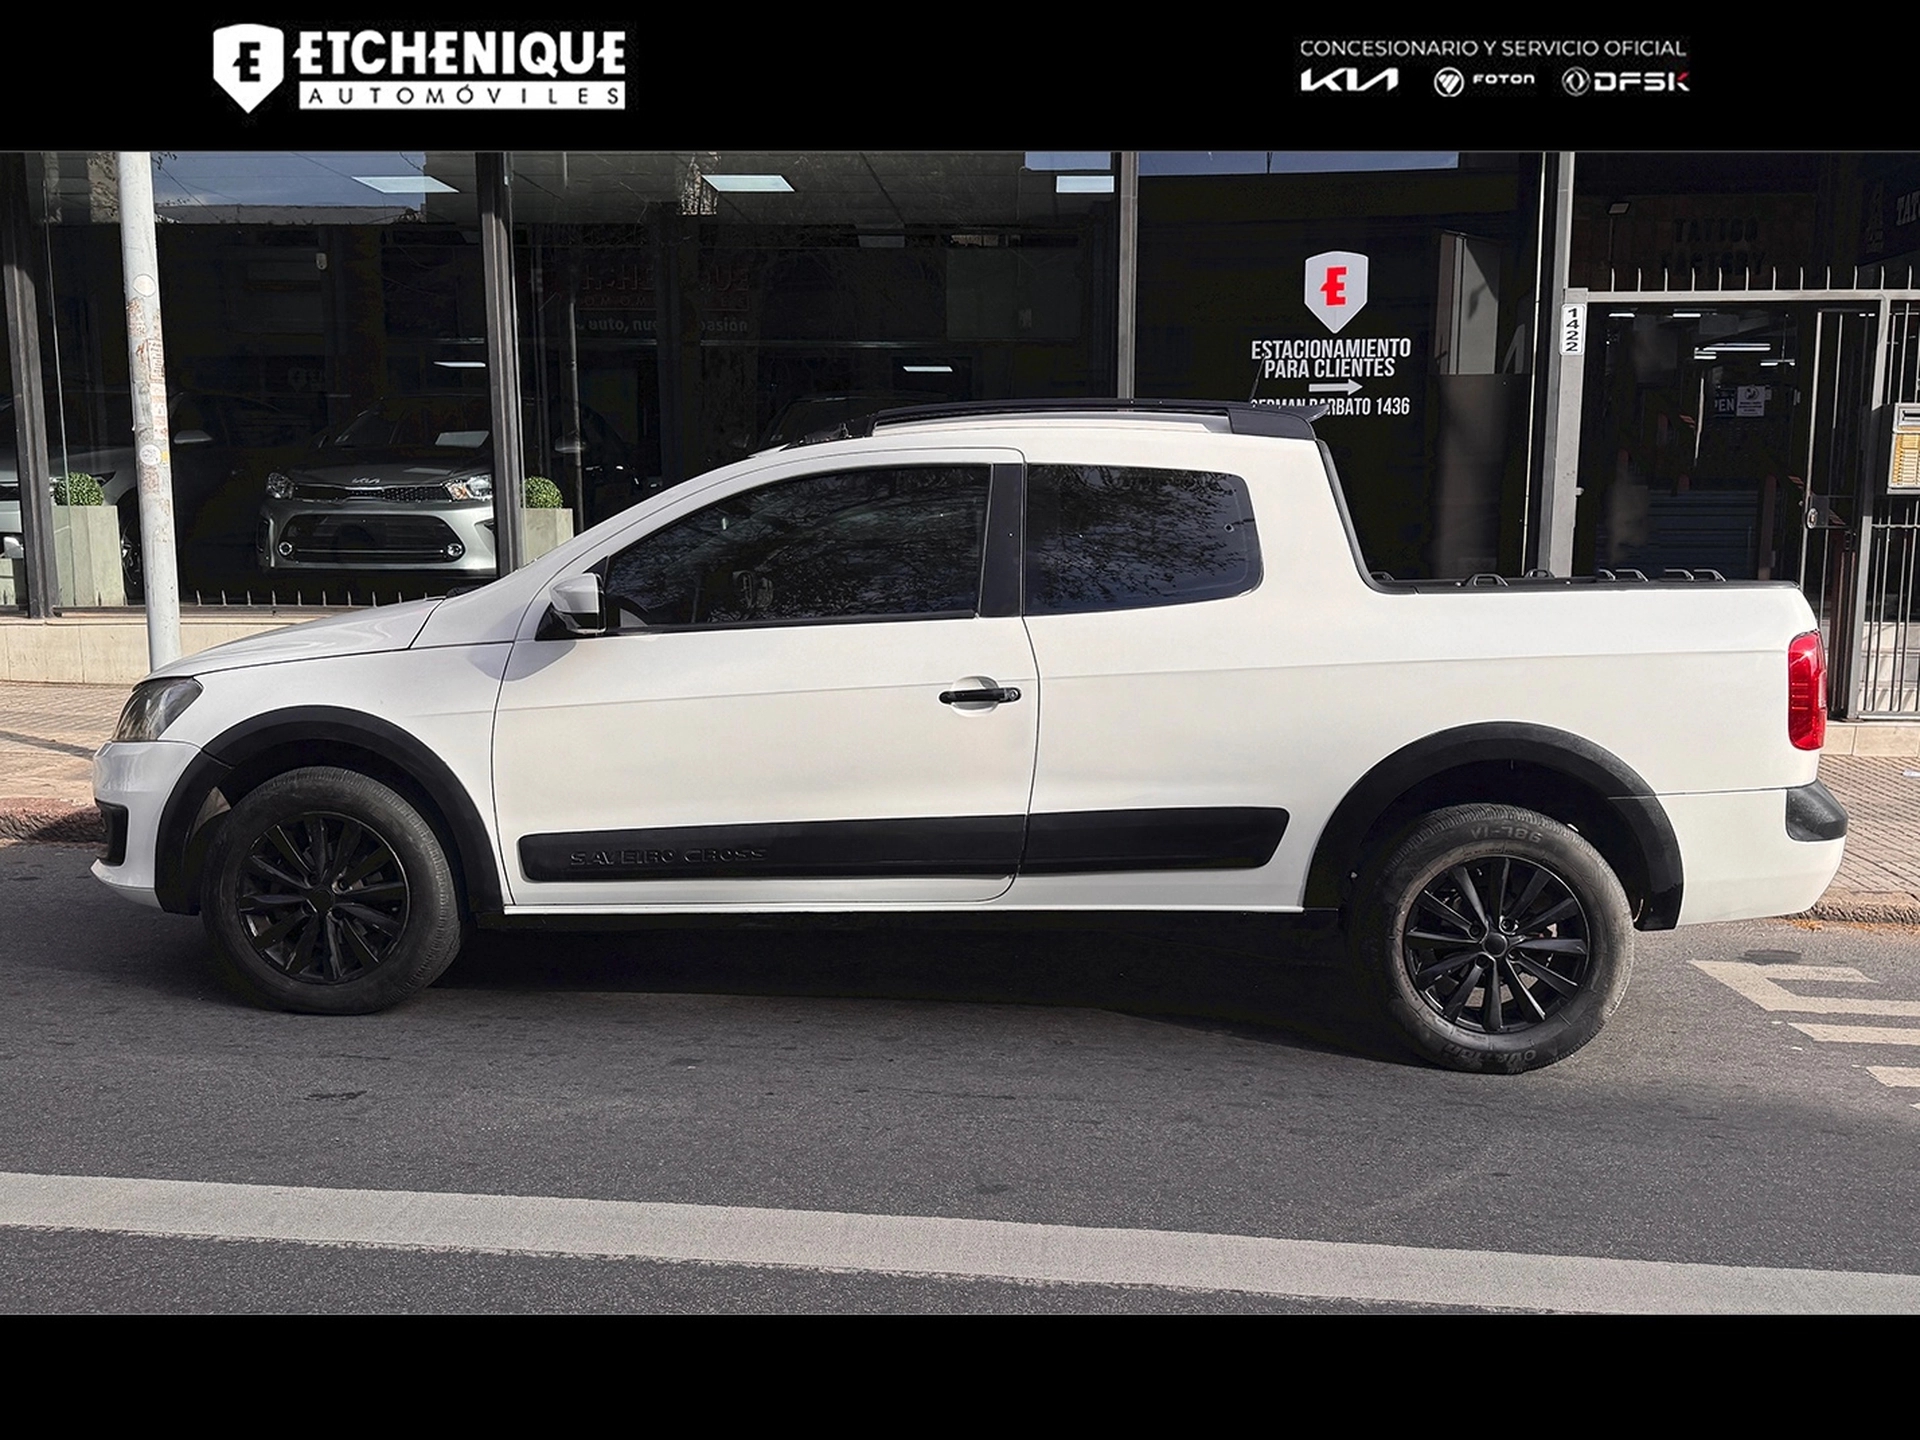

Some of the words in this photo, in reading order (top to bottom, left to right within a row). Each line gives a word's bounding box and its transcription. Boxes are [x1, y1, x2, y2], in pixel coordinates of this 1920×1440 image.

[1896, 190, 1920, 226] TAT
[1566, 308, 1579, 352] 1422
[1251, 338, 1411, 360] ESTACIONAMIENTO
[1264, 359, 1310, 379] PARA
[1314, 358, 1396, 378] CLIENTES
[1376, 397, 1410, 415] 1436
[570, 849, 676, 865] SAVEIRO
[683, 848, 767, 863] CROSS
